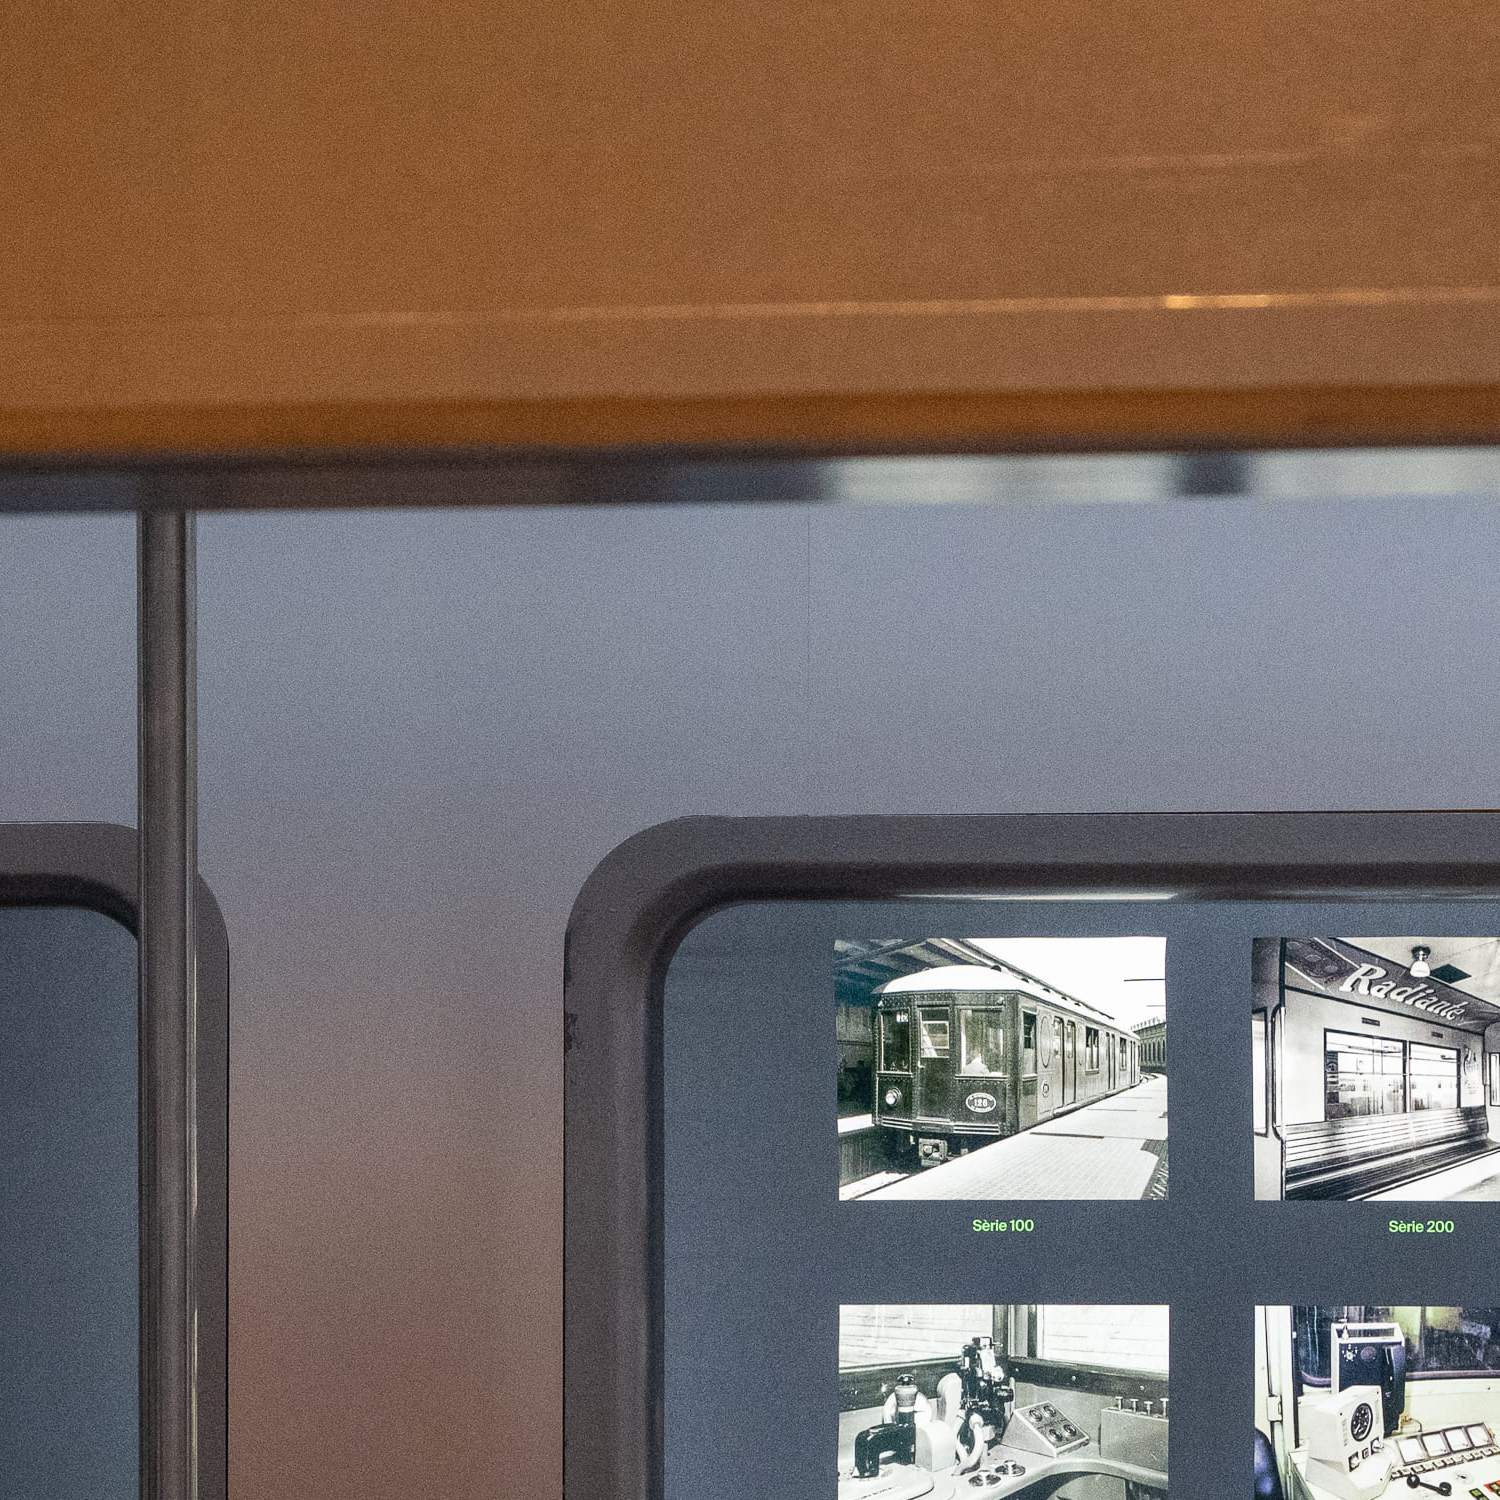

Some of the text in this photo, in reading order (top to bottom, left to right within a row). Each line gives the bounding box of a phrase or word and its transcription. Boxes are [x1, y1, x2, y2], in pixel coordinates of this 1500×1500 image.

[1339, 963, 1468, 1021] Radiante
[971, 1218, 1035, 1233] Sèrie 100
[1388, 1219, 1455, 1234] Sèrie 200
